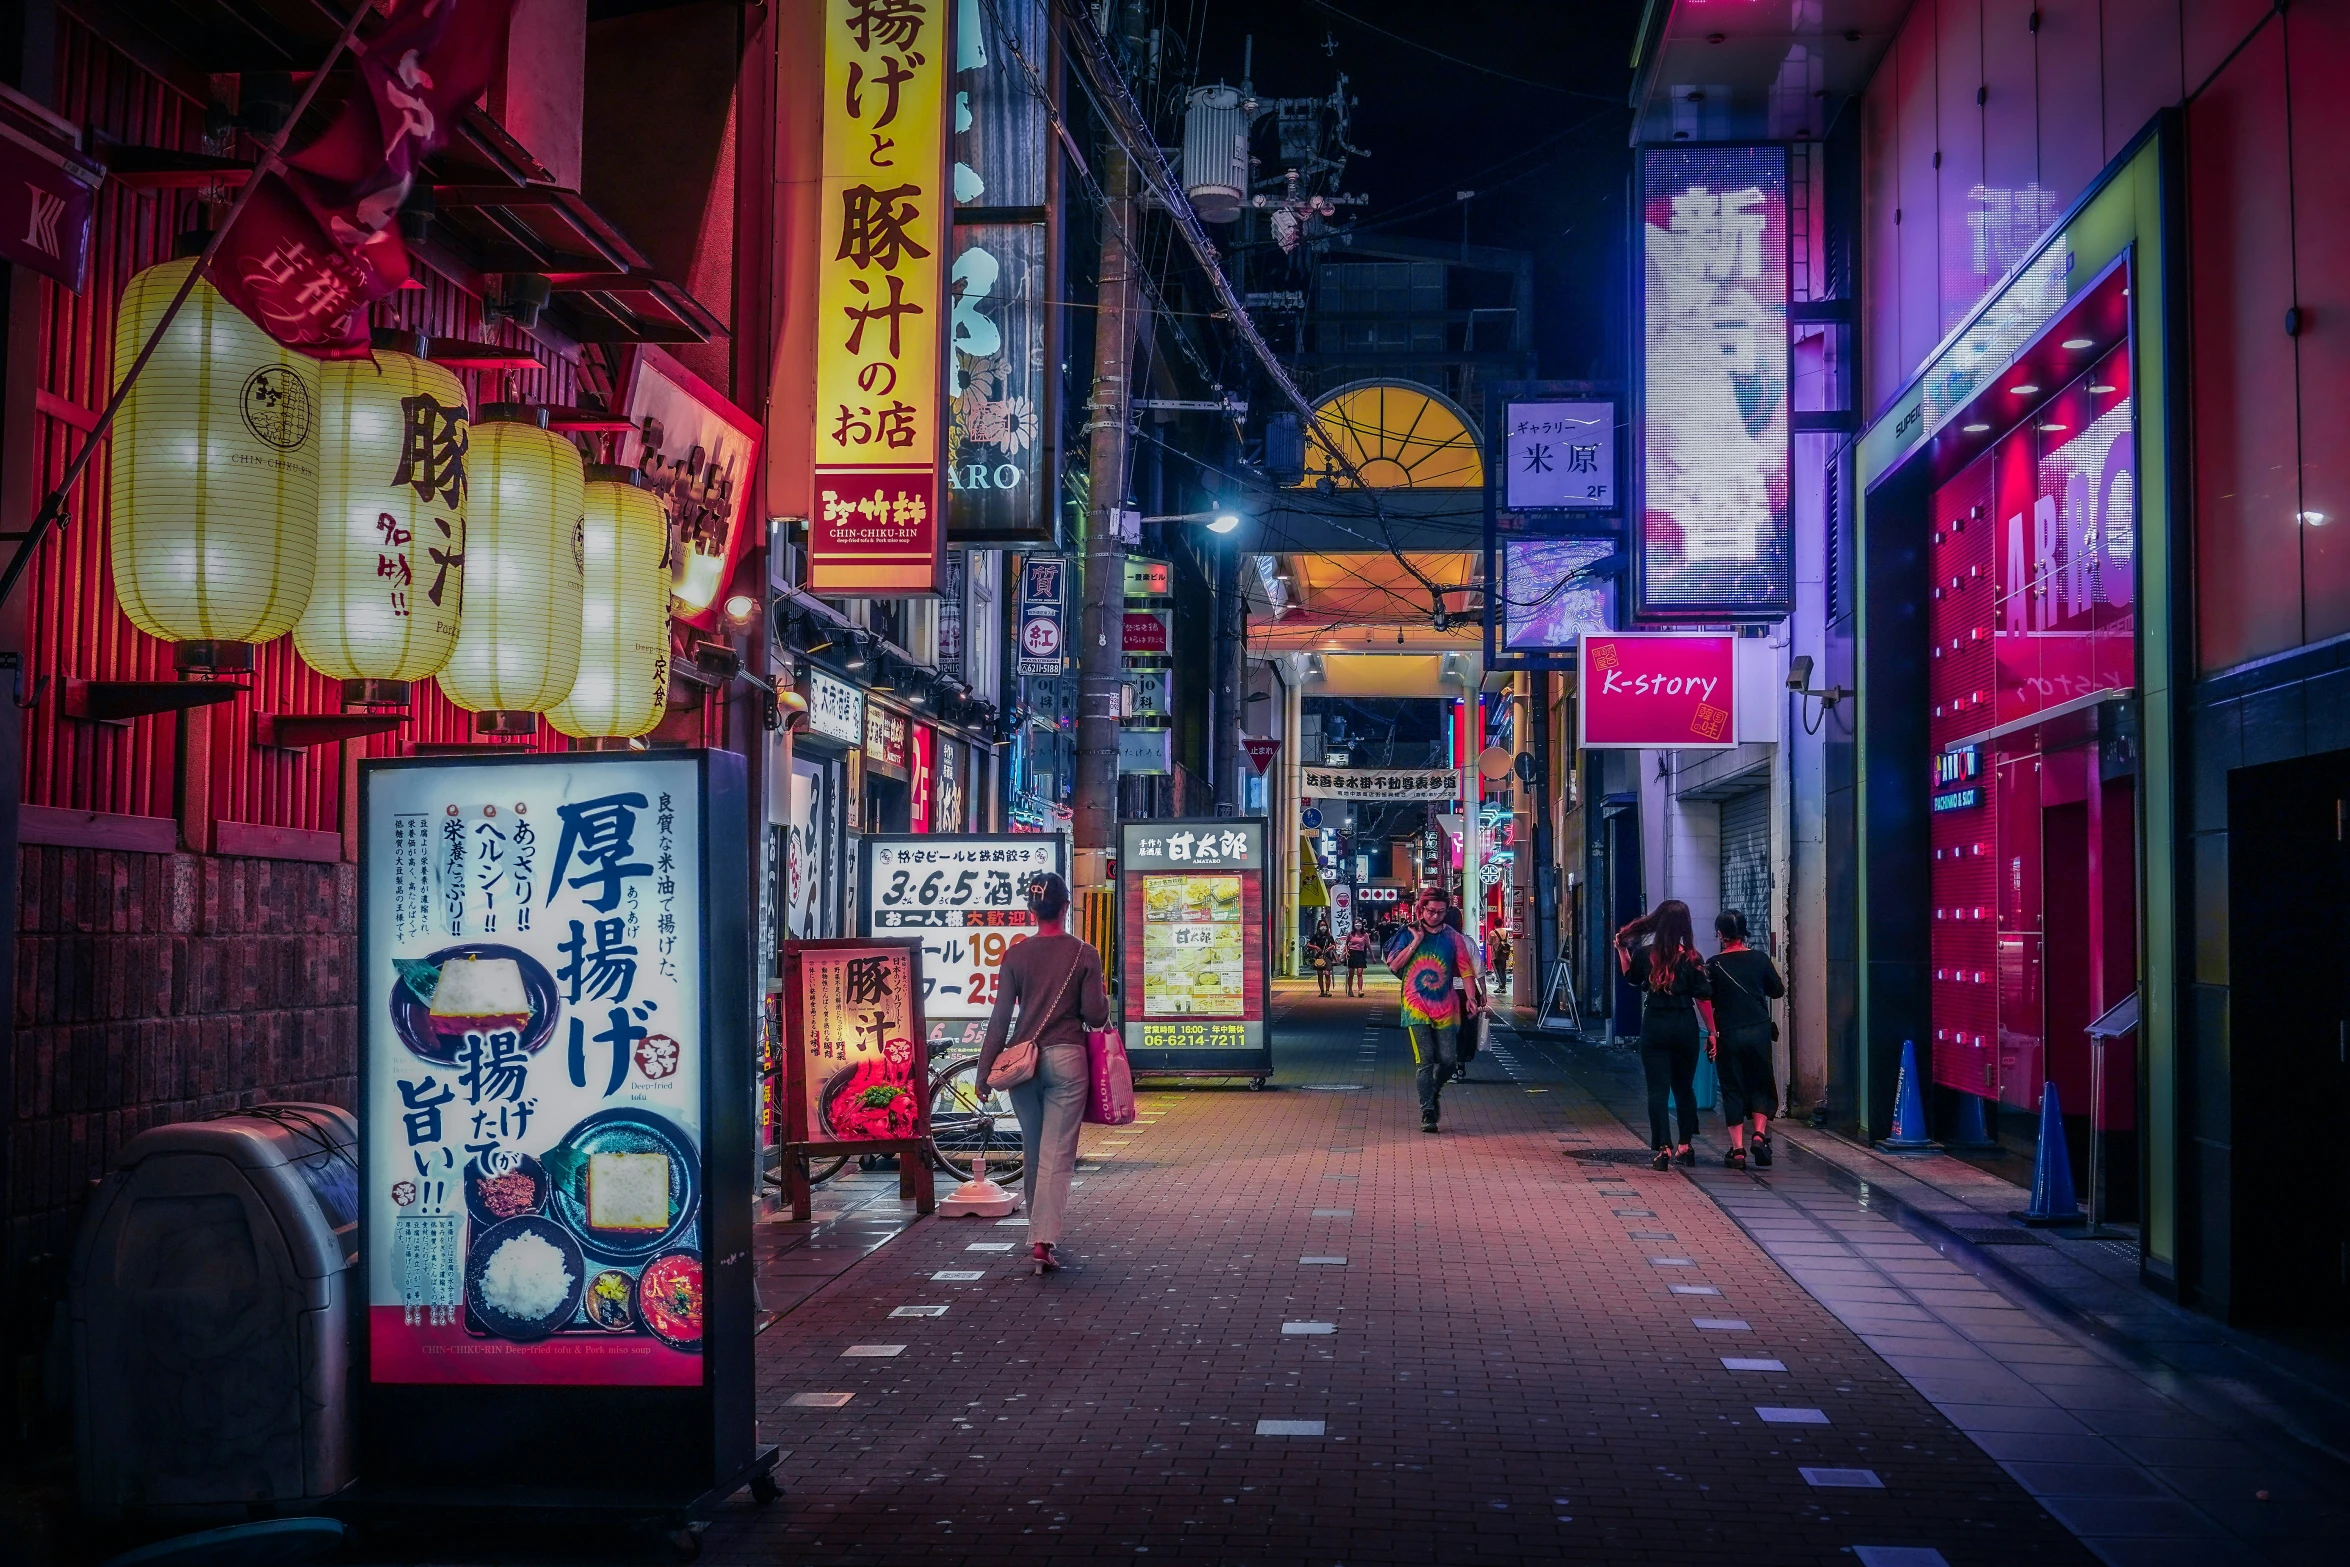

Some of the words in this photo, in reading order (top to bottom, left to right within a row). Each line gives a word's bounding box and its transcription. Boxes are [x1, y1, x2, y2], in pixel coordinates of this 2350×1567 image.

[1517, 420, 1577, 434] ギャラリー
[1896, 403, 1922, 439] SUPER
[231, 454, 313, 477] CHIN-CHIKU-RIN
[1522, 442, 1599, 474] 米原
[1587, 485, 1606, 497] 2F
[829, 528, 917, 538] CHIN-CHIKU-RIN
[1031, 565, 1059, 597] 質
[1029, 624, 1054, 648] 紅
[653, 655, 667, 708] 定食
[1602, 669, 1718, 702] K-story
[821, 680, 851, 722] 大衆酒場
[1250, 746, 1274, 756] 止まれ
[1942, 751, 1975, 782] ARROW
[1934, 792, 1958, 812] PACHINKO
[1139, 839, 1162, 848] 手作り
[1139, 848, 1163, 857] 居酒屋
[1166, 830, 1248, 861] 甘太郎
[897, 850, 1030, 862] 格安ビールと鉄鍋餃子
[656, 791, 678, 984] 良質な米油で揚げた、
[626, 885, 640, 939] あつあげ
[545, 791, 658, 1100] 厚揚げ
[1175, 928, 1212, 944] 甘太郎
[846, 956, 896, 1054] 豚汁
[1143, 1025, 1176, 1034] 営業時間
[1211, 1025, 1245, 1034] 年中無休
[1144, 1034, 1246, 1047] 06-6214-7211
[631, 1081, 673, 1091] Deep-fried
[631, 1093, 648, 1101] tofu
[421, 1345, 502, 1355] CHIN-CHIKU-RIN
[505, 1345, 551, 1355] Deep-fried
[554, 1345, 572, 1355] tofu
[574, 1345, 582, 1355] &
[585, 1345, 605, 1355] Pork
[608, 1345, 629, 1355] miso
[631, 1347, 651, 1356] soup
